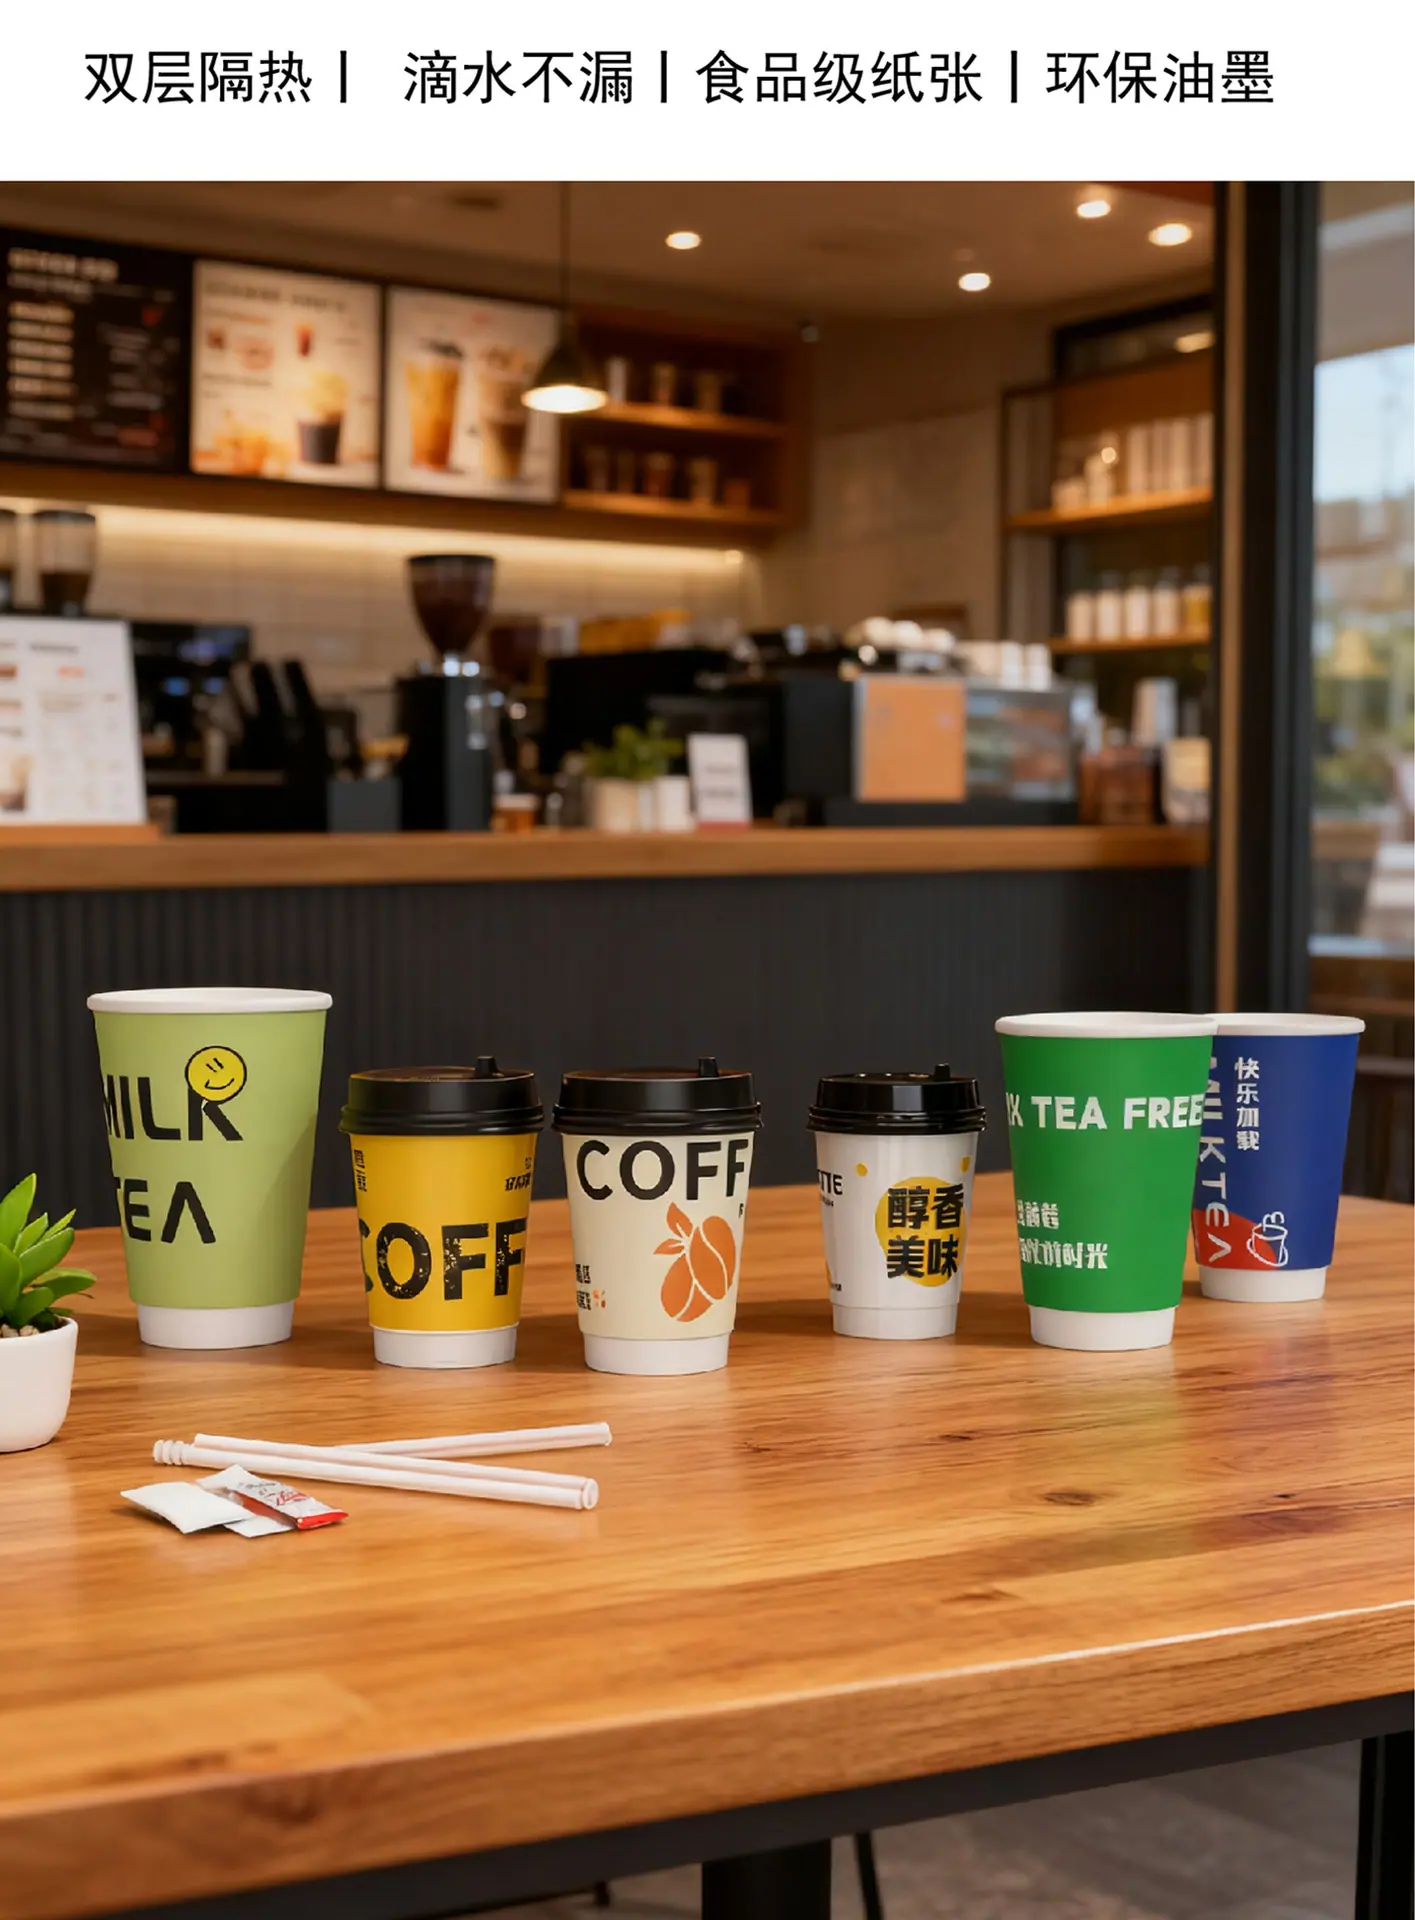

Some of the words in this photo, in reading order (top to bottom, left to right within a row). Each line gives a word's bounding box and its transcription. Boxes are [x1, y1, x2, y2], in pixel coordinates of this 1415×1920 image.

[1030, 1095, 1108, 1130] TEA
[1234, 1056, 1260, 1151] 快乐加载
[576, 1138, 750, 1201] COFF
[887, 1182, 965, 1230] 醇香
[358, 1217, 528, 1301] OFF
[886, 1233, 960, 1279] 美味
